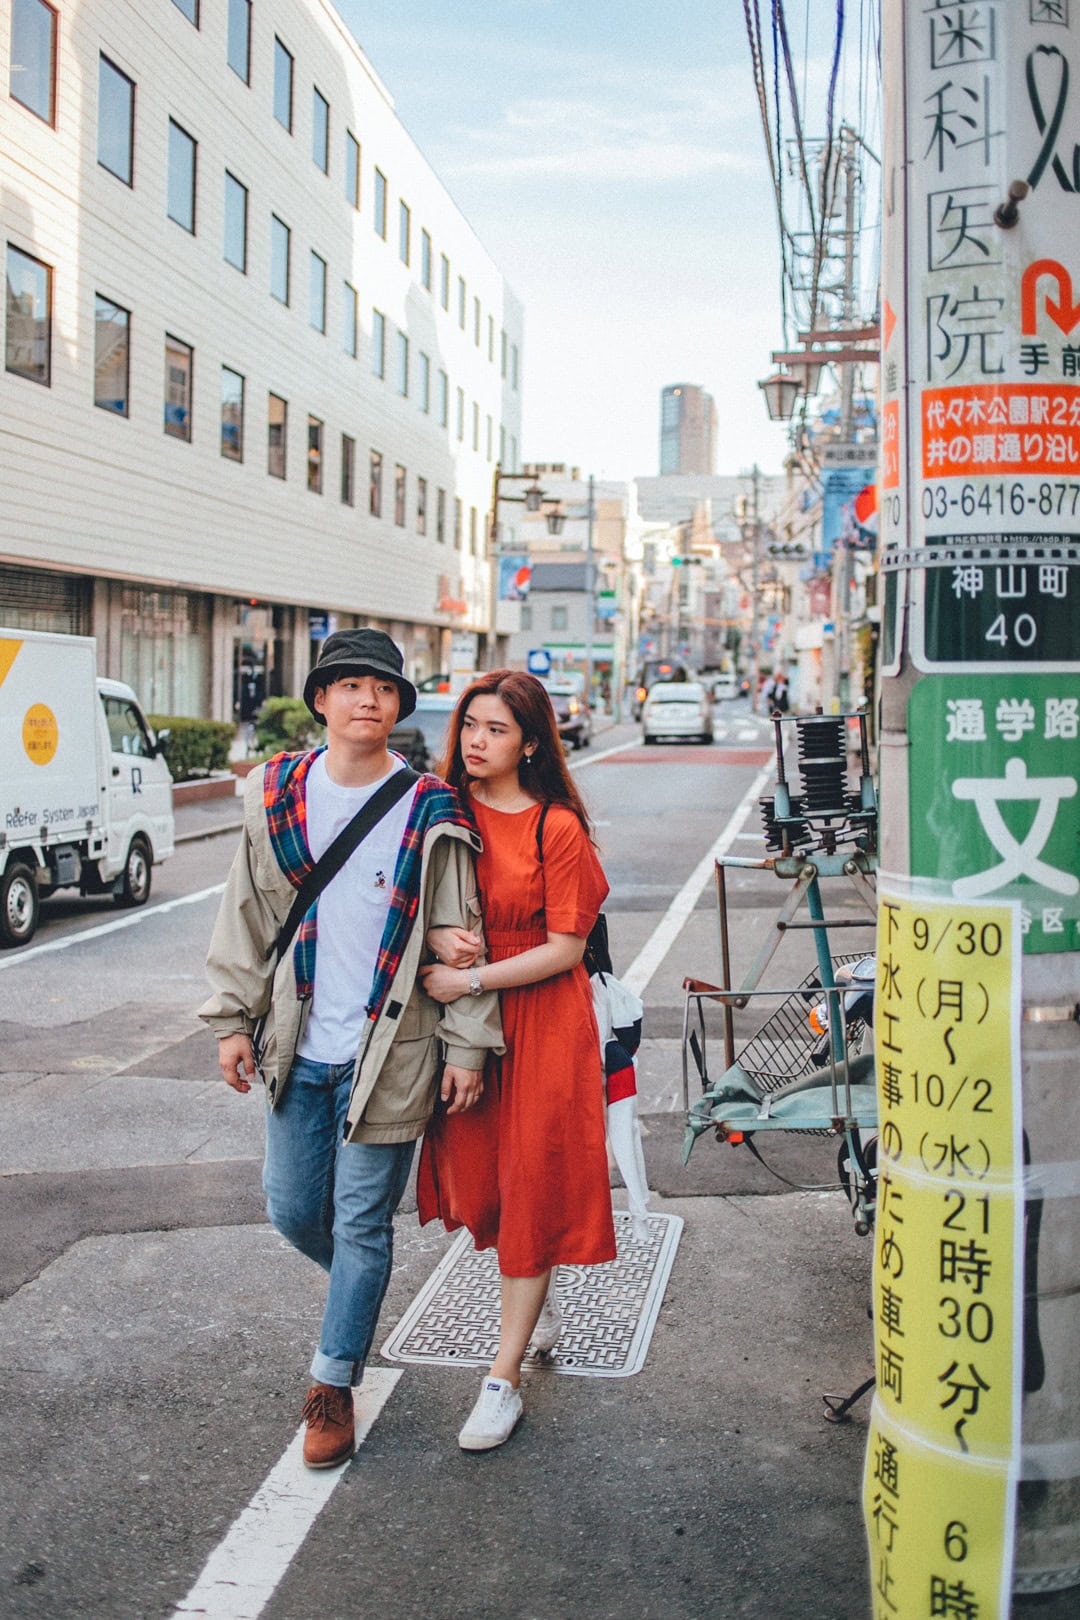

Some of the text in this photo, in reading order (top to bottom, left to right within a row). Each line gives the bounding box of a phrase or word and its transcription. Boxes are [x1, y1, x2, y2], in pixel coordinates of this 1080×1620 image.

[951, 564, 1069, 600] 神山町
[984, 613, 1038, 648] 40
[945, 696, 1080, 742] 通学路
[42, 808, 74, 824] System
[951, 756, 1080, 899] 文
[912, 917, 1003, 957] 9/30
[910, 1070, 994, 1113] 10/2
